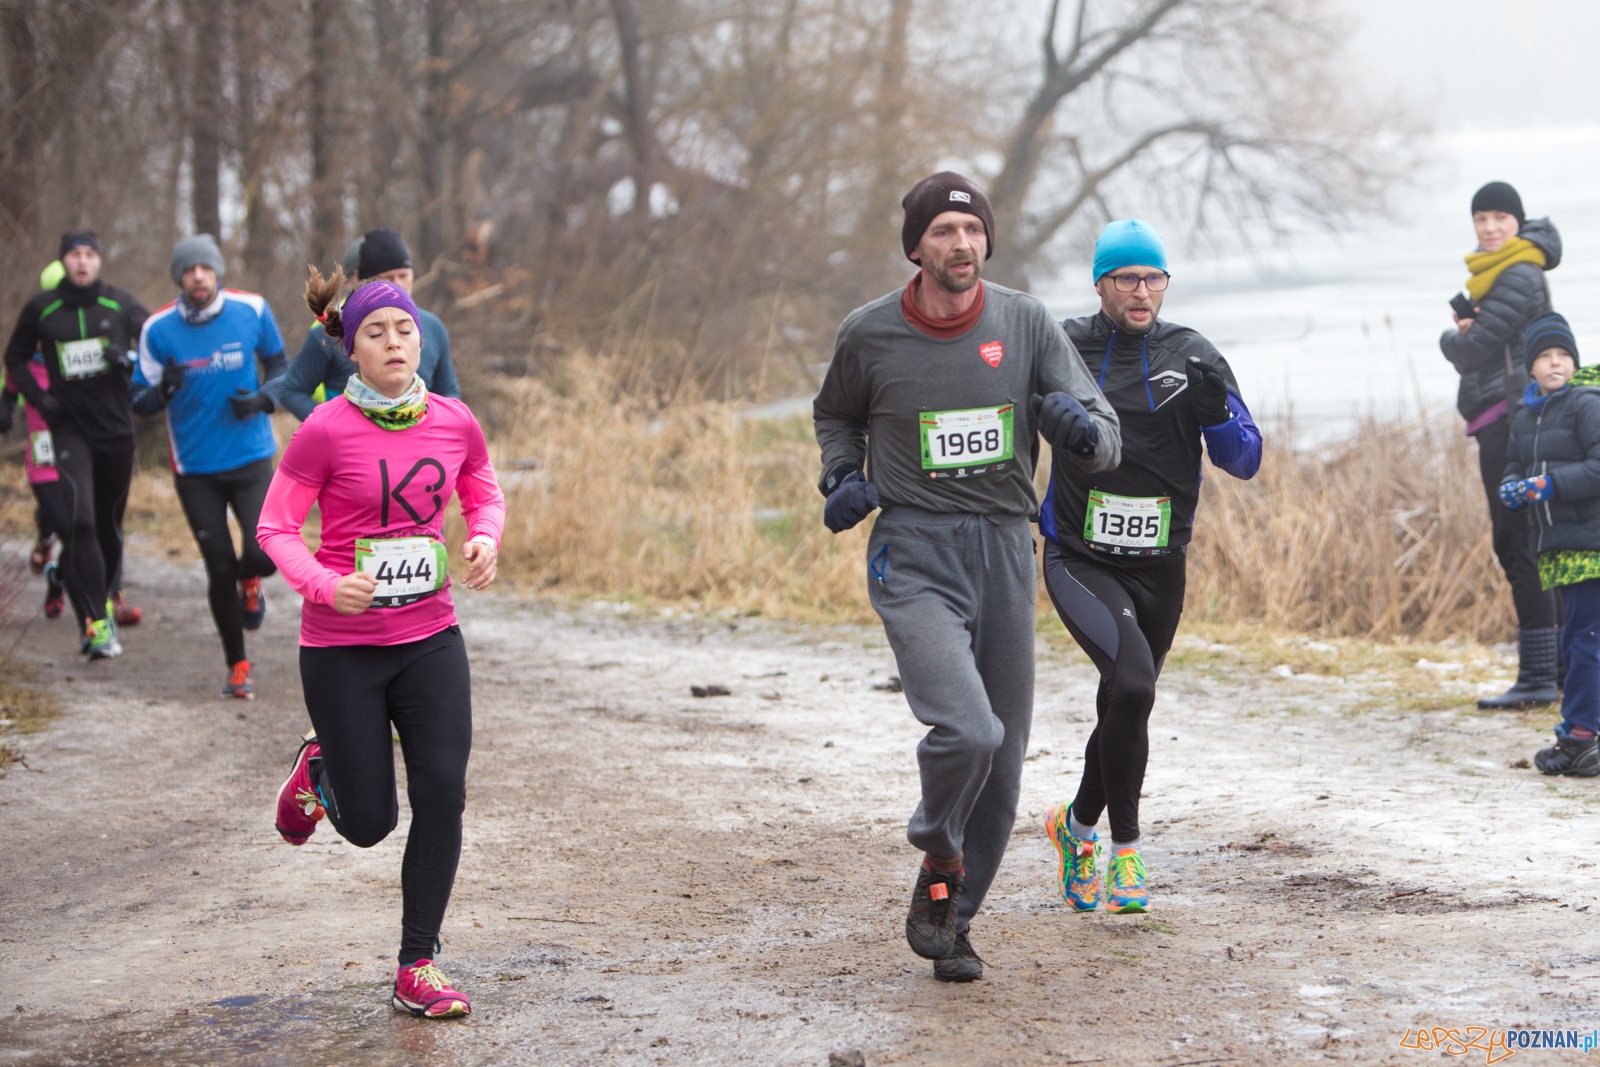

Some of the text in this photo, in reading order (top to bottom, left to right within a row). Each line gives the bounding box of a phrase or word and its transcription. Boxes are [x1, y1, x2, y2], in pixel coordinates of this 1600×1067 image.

[936, 428, 999, 457] 1968
[1098, 512, 1160, 538] 1385
[1110, 538, 1145, 546] KLAUDIUSZ
[375, 557, 432, 585] 444
[387, 586, 407, 595] ZOFIA
